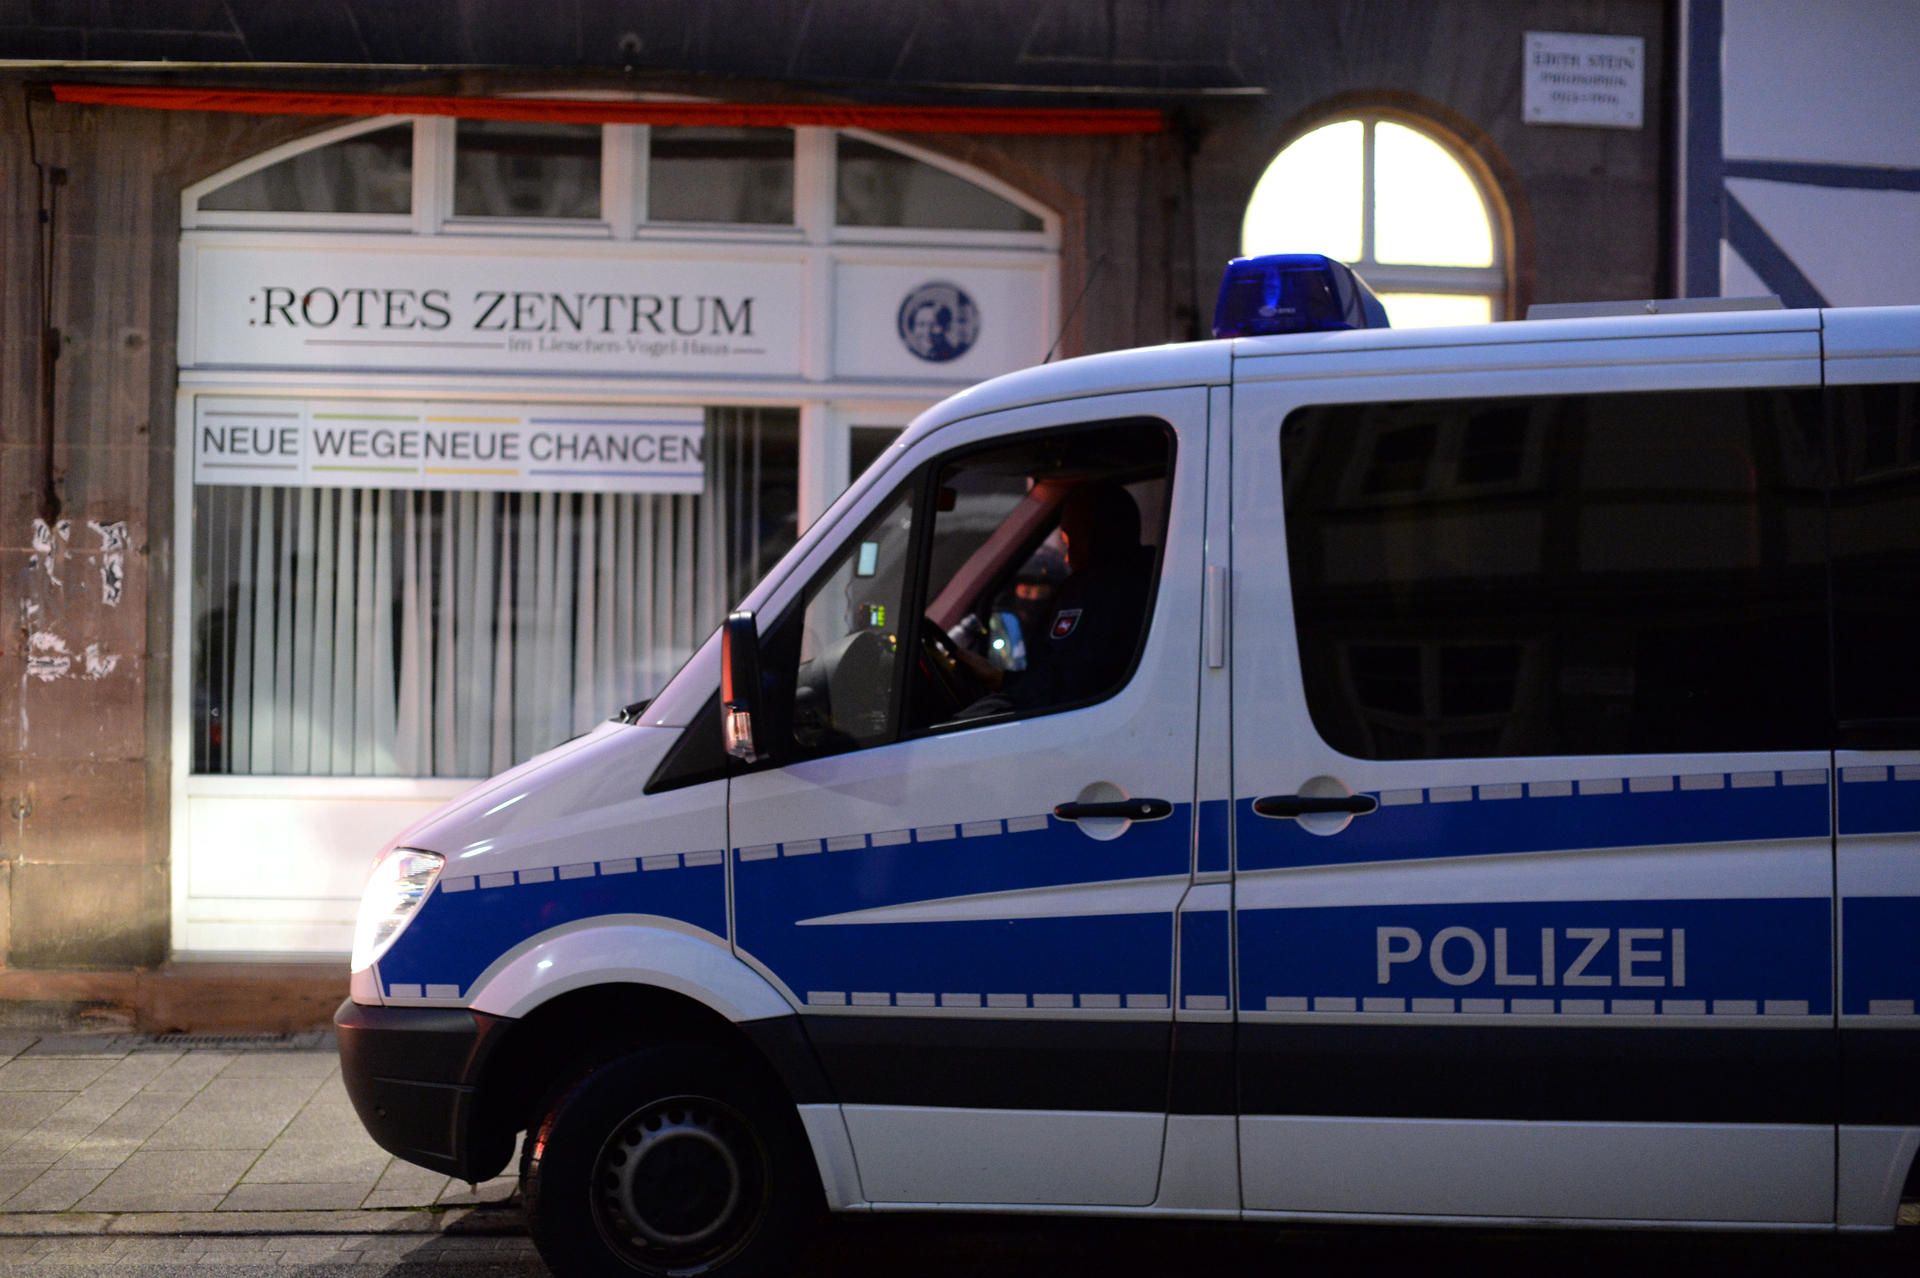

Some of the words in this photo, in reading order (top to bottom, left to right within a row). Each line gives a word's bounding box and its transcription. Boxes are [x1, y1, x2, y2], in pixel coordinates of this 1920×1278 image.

[473, 290, 755, 336] ZENTRUM
[203, 426, 299, 455] NEUE
[313, 429, 418, 459] WEGE
[424, 431, 519, 461] NEUE
[529, 432, 705, 463] CHANCEN
[1376, 926, 1686, 988] POLIZEI
